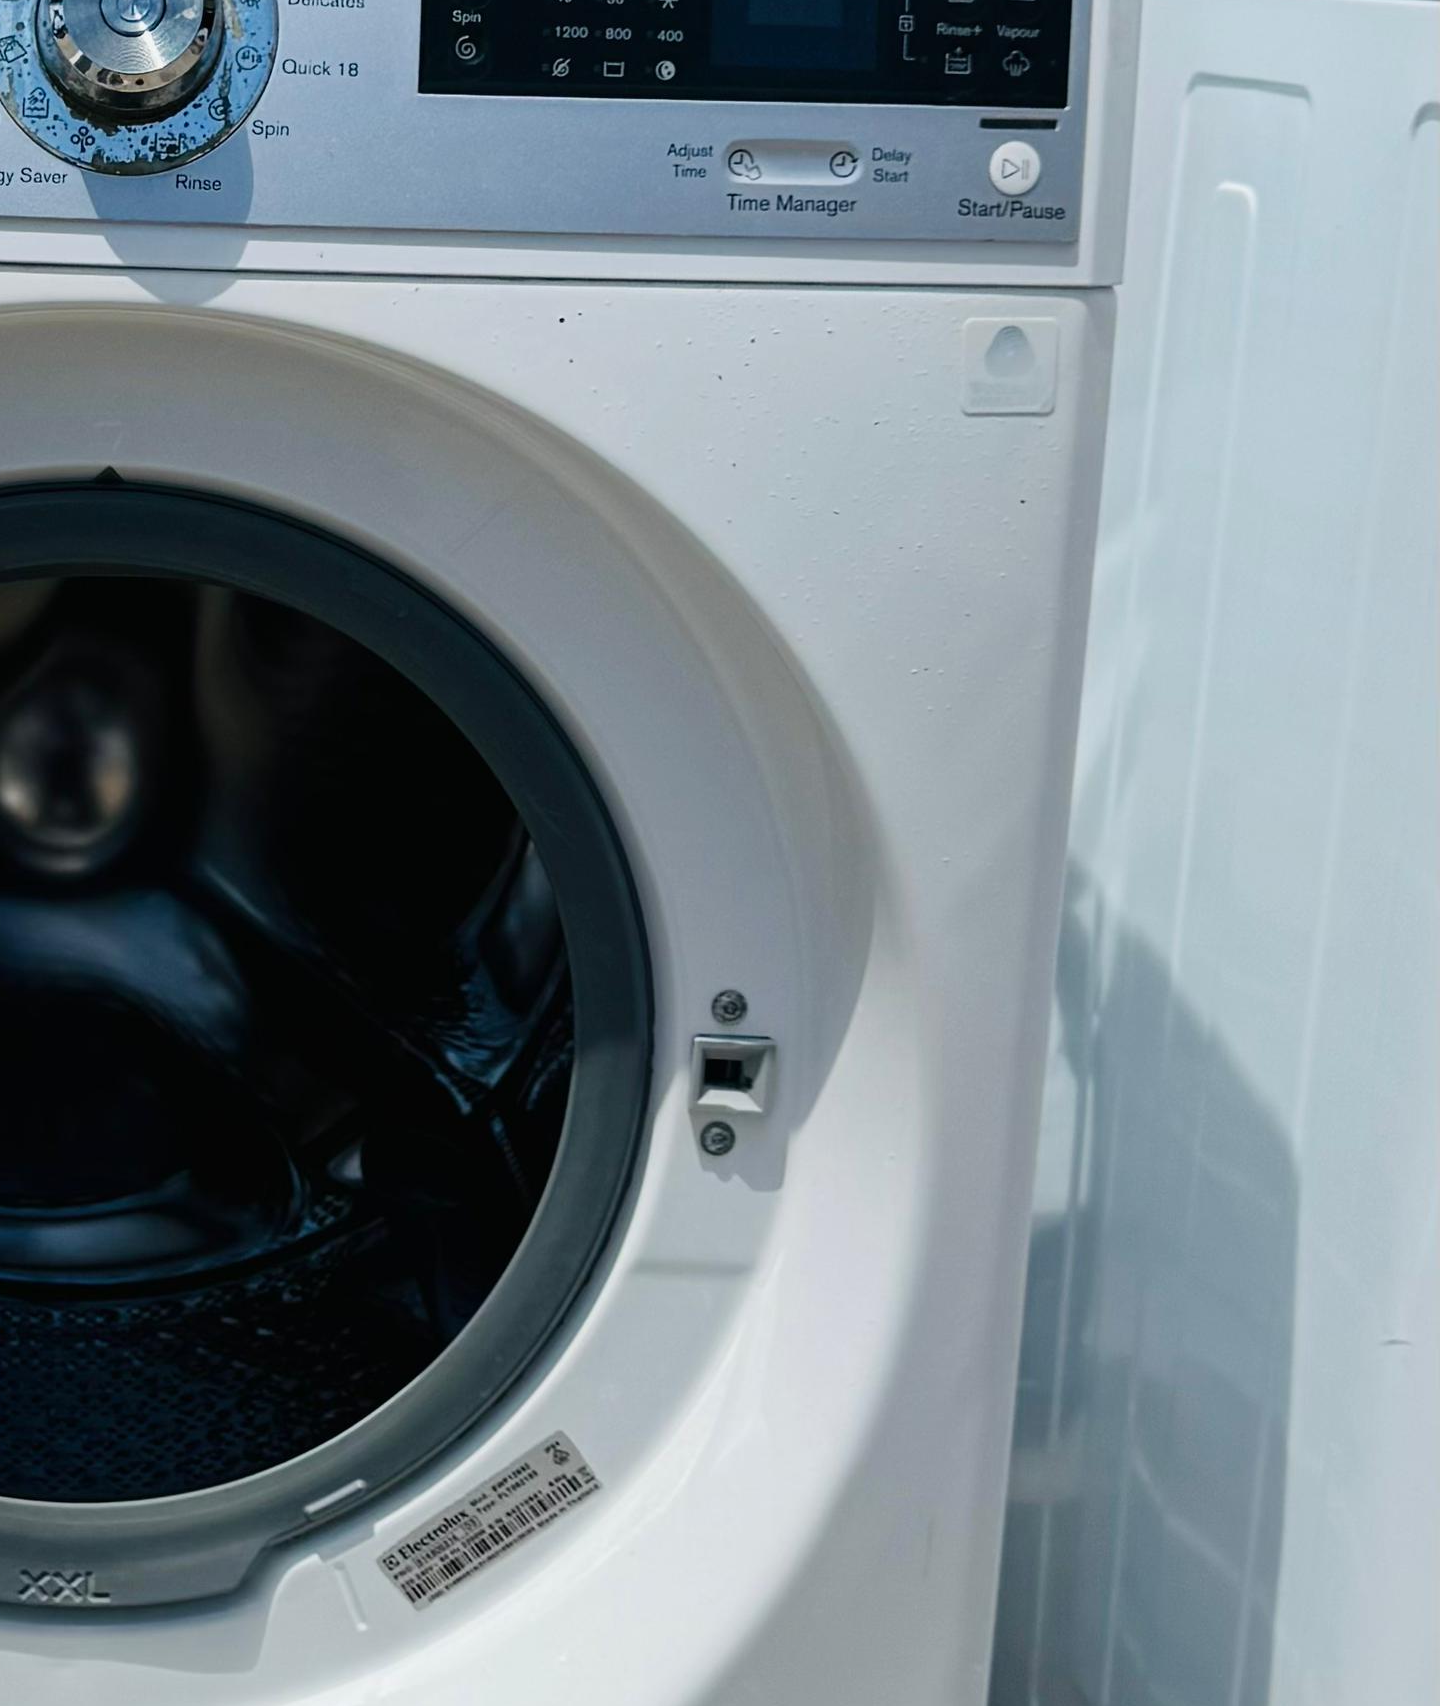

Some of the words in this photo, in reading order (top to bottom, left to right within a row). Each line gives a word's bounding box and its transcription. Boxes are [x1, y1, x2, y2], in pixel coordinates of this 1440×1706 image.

[452, 10, 481, 25] Spin
[555, 26, 588, 39] 1200
[605, 28, 632, 41] 800
[657, 30, 684, 42] 400
[996, 24, 1041, 39] Vapour
[282, 59, 331, 76] Quick
[338, 63, 359, 77] 18
[252, 120, 290, 139] Spin
[666, 143, 714, 159] Adjust
[871, 147, 912, 165] Delay
[20, 167, 68, 184] Saver
[673, 164, 706, 178] Time
[872, 168, 909, 183] Start
[175, 174, 222, 191] Rinse
[726, 193, 770, 212] Time
[776, 196, 857, 216] Manager
[958, 199, 1066, 220] Start/Pause
[398, 1510, 470, 1560] Electrolux
[19, 1569, 111, 1603] XXL
